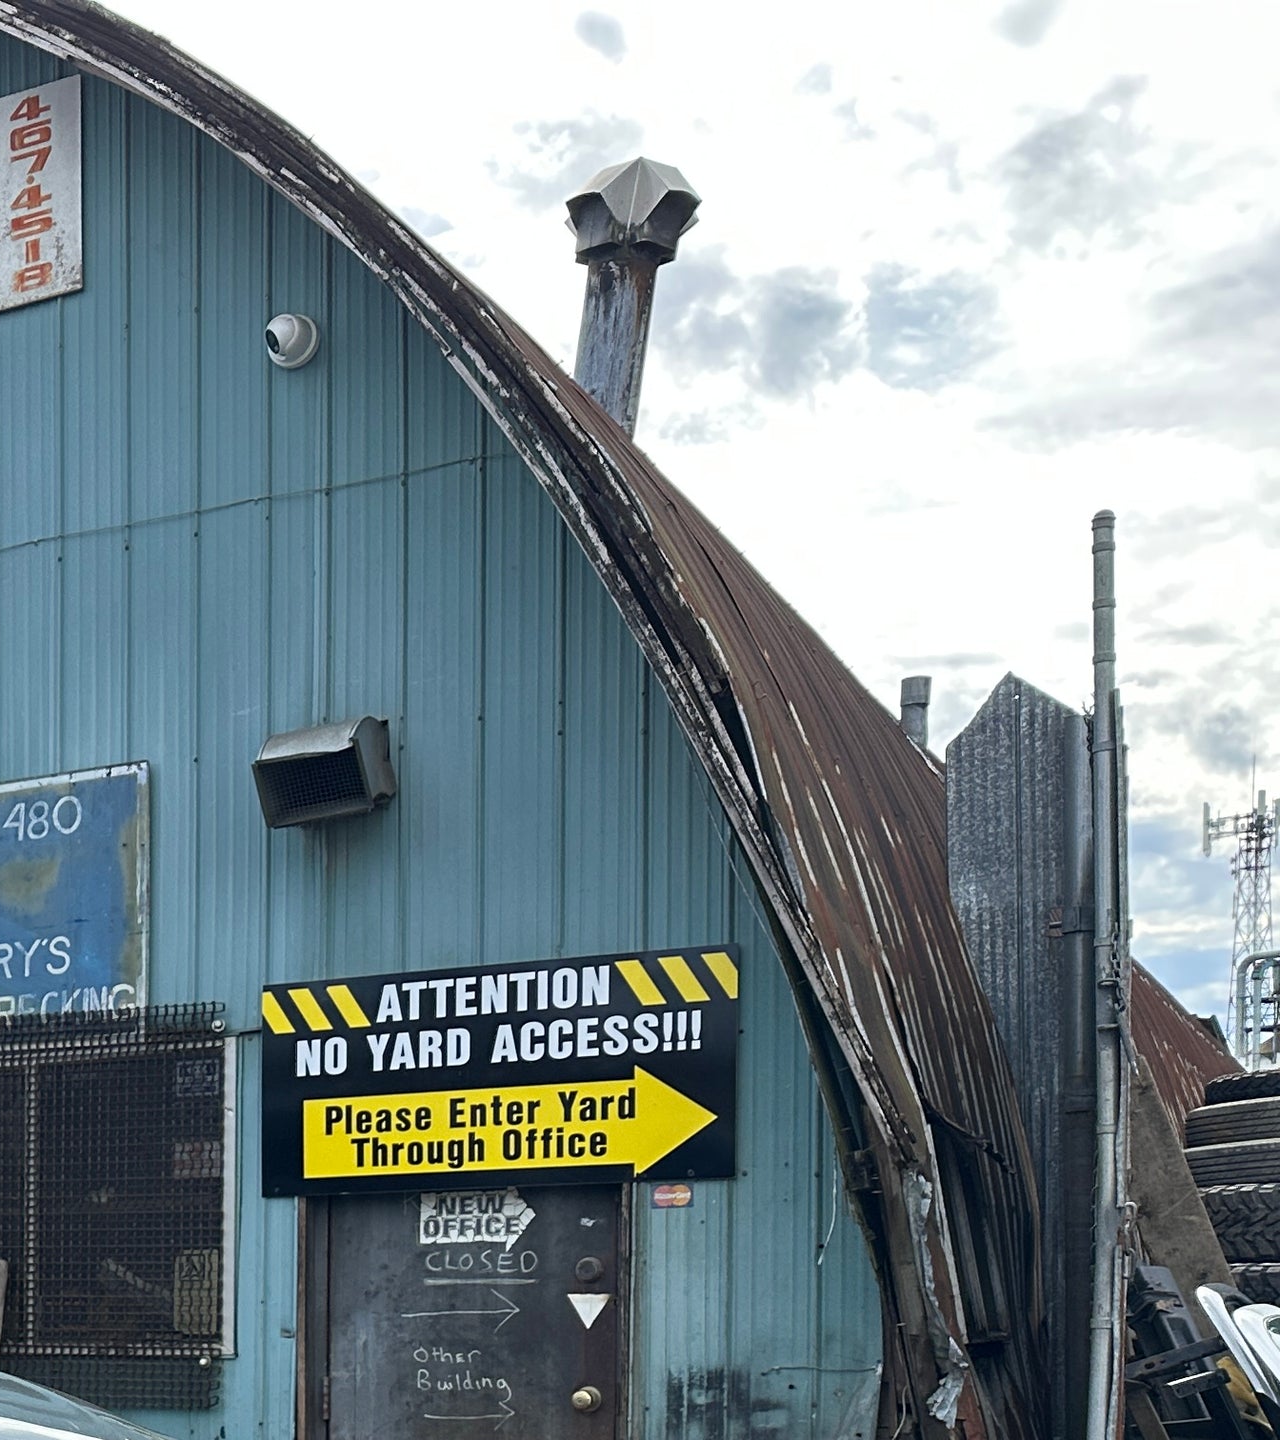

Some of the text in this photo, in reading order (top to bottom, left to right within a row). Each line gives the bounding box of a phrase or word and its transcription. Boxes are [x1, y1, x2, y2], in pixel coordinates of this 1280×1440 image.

[376, 964, 611, 1023] ATTENTION
[295, 1010, 703, 1078] NO YARD ACCESS!!!
[324, 1087, 637, 1136] Please Enter Yard
[351, 1127, 609, 1169] Through Office
[438, 1194, 503, 1216] NEW
[423, 1216, 520, 1239] OFFICE
[426, 1250, 538, 1273] CLOSED
[417, 1369, 512, 1403] Building
